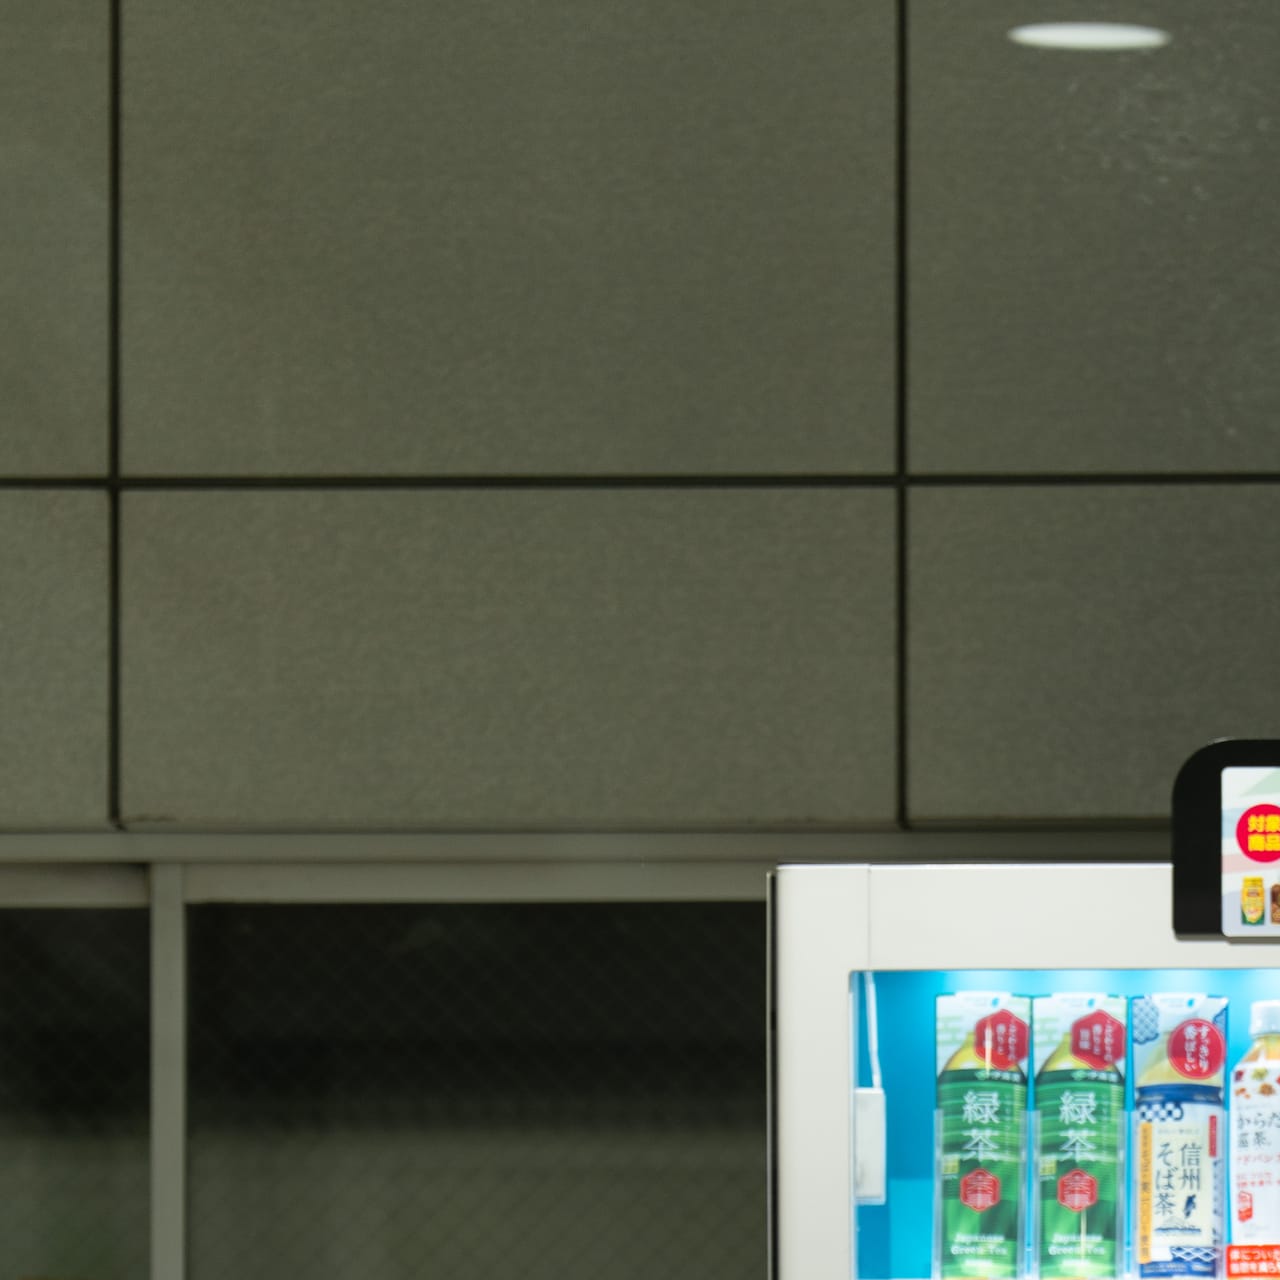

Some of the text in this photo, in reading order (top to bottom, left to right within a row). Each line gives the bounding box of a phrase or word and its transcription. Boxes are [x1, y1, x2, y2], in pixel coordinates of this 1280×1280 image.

[962, 1090, 1001, 1163] 緑茶
[1059, 1090, 1098, 1163] 緑茶
[1155, 1143, 1176, 1217] そば茶
[1180, 1143, 1201, 1190] 信州
